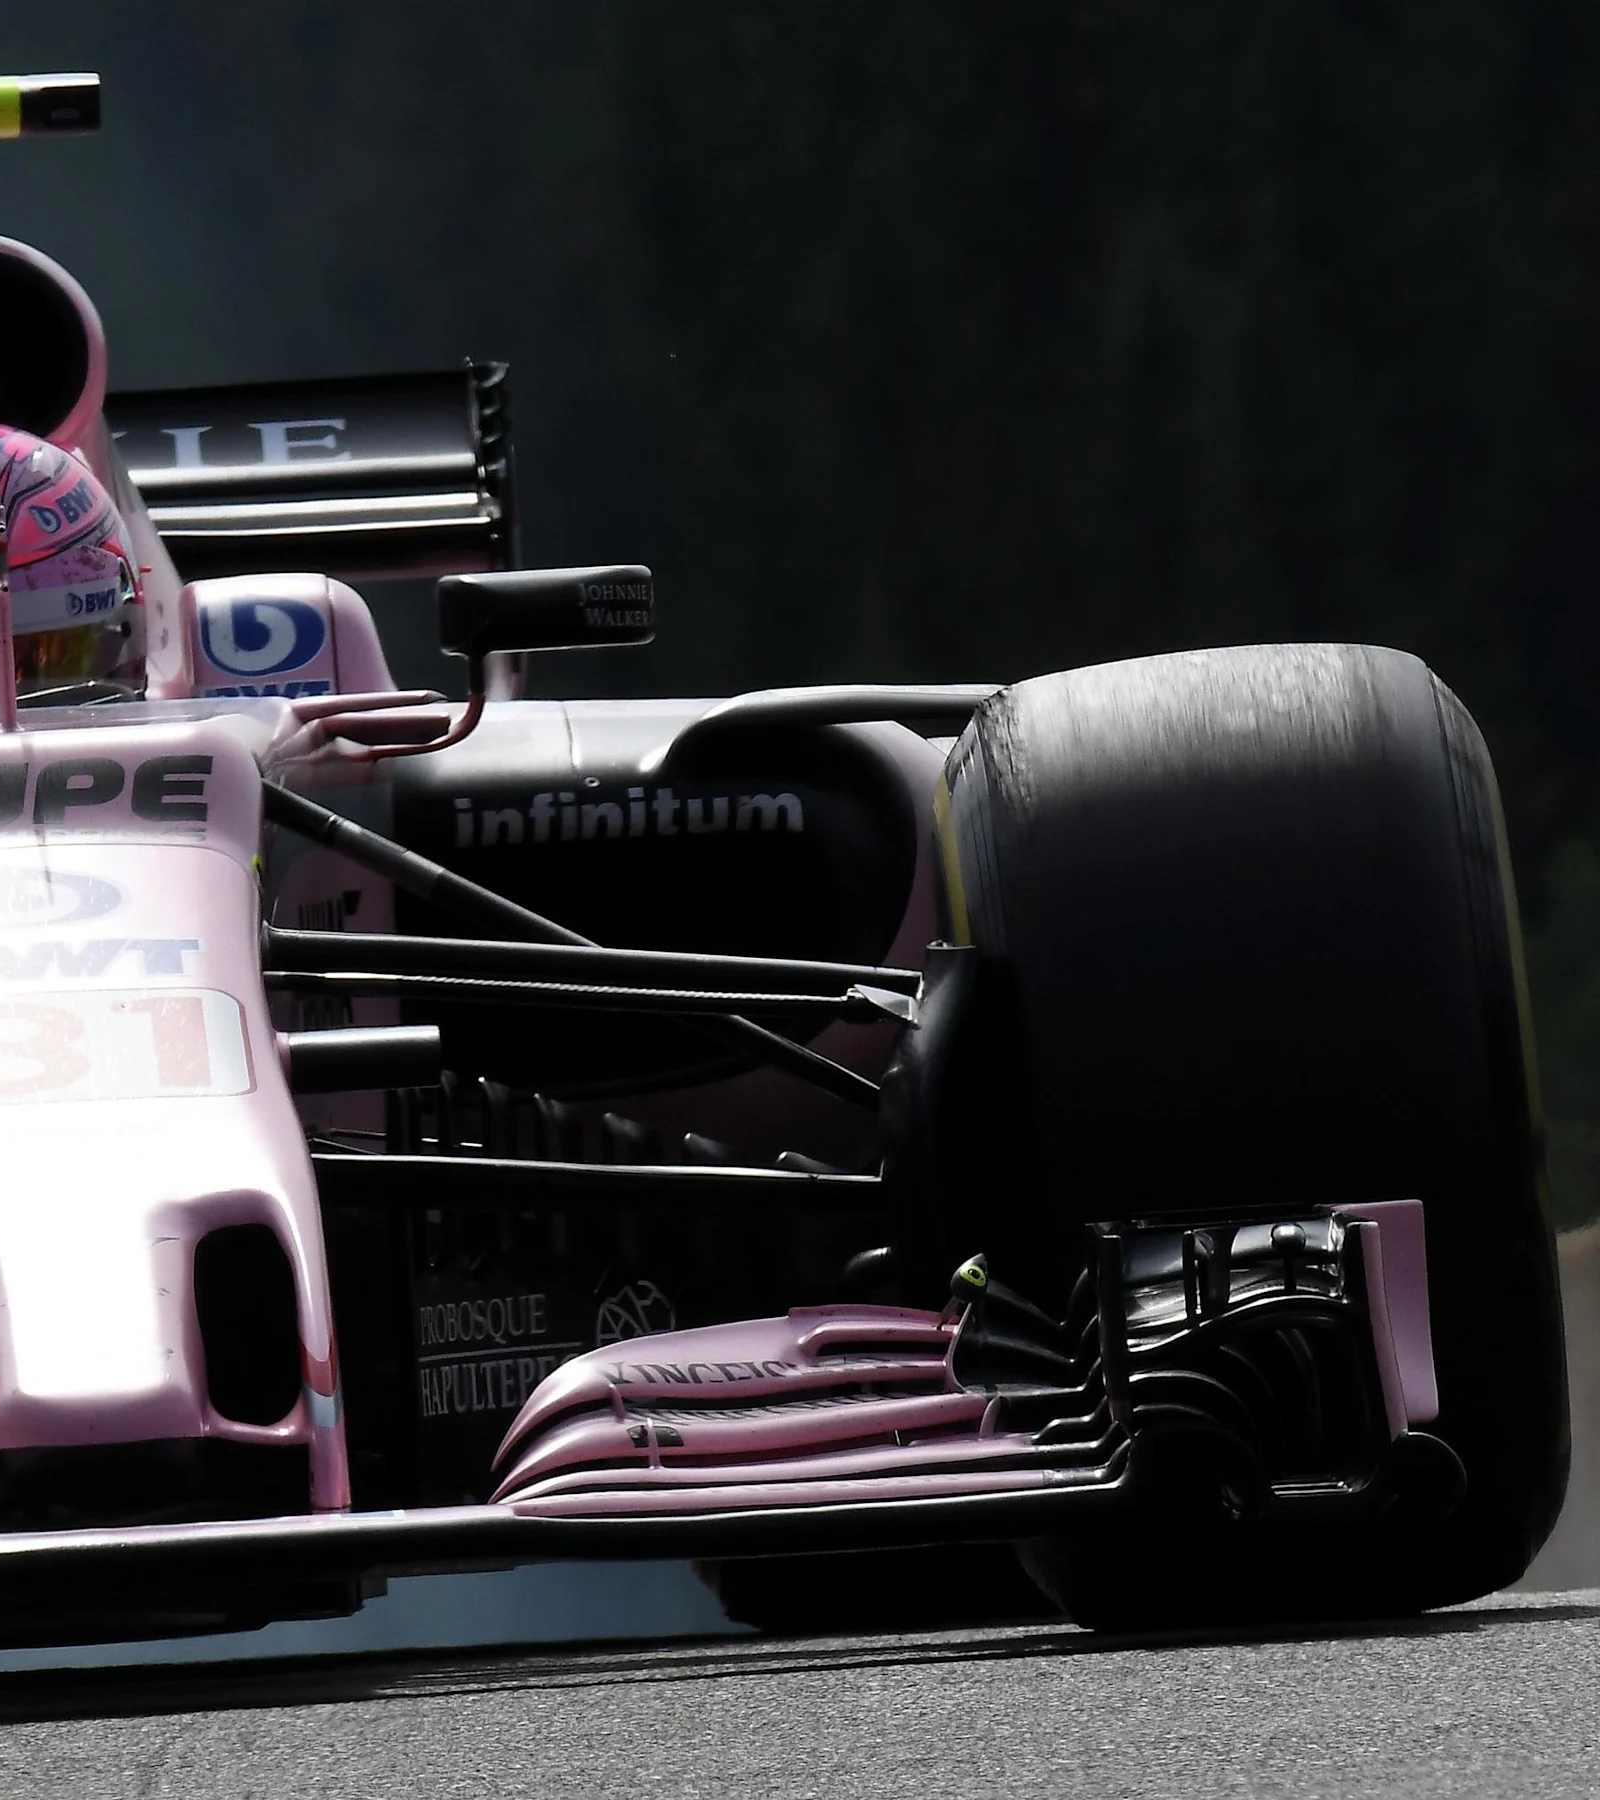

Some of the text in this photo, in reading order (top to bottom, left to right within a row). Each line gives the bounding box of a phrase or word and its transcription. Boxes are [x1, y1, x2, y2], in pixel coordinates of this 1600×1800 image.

[579, 582, 649, 606] JOHNNIE
[454, 786, 804, 849] infinitum
[420, 1294, 548, 1345] PROBOSQUE
